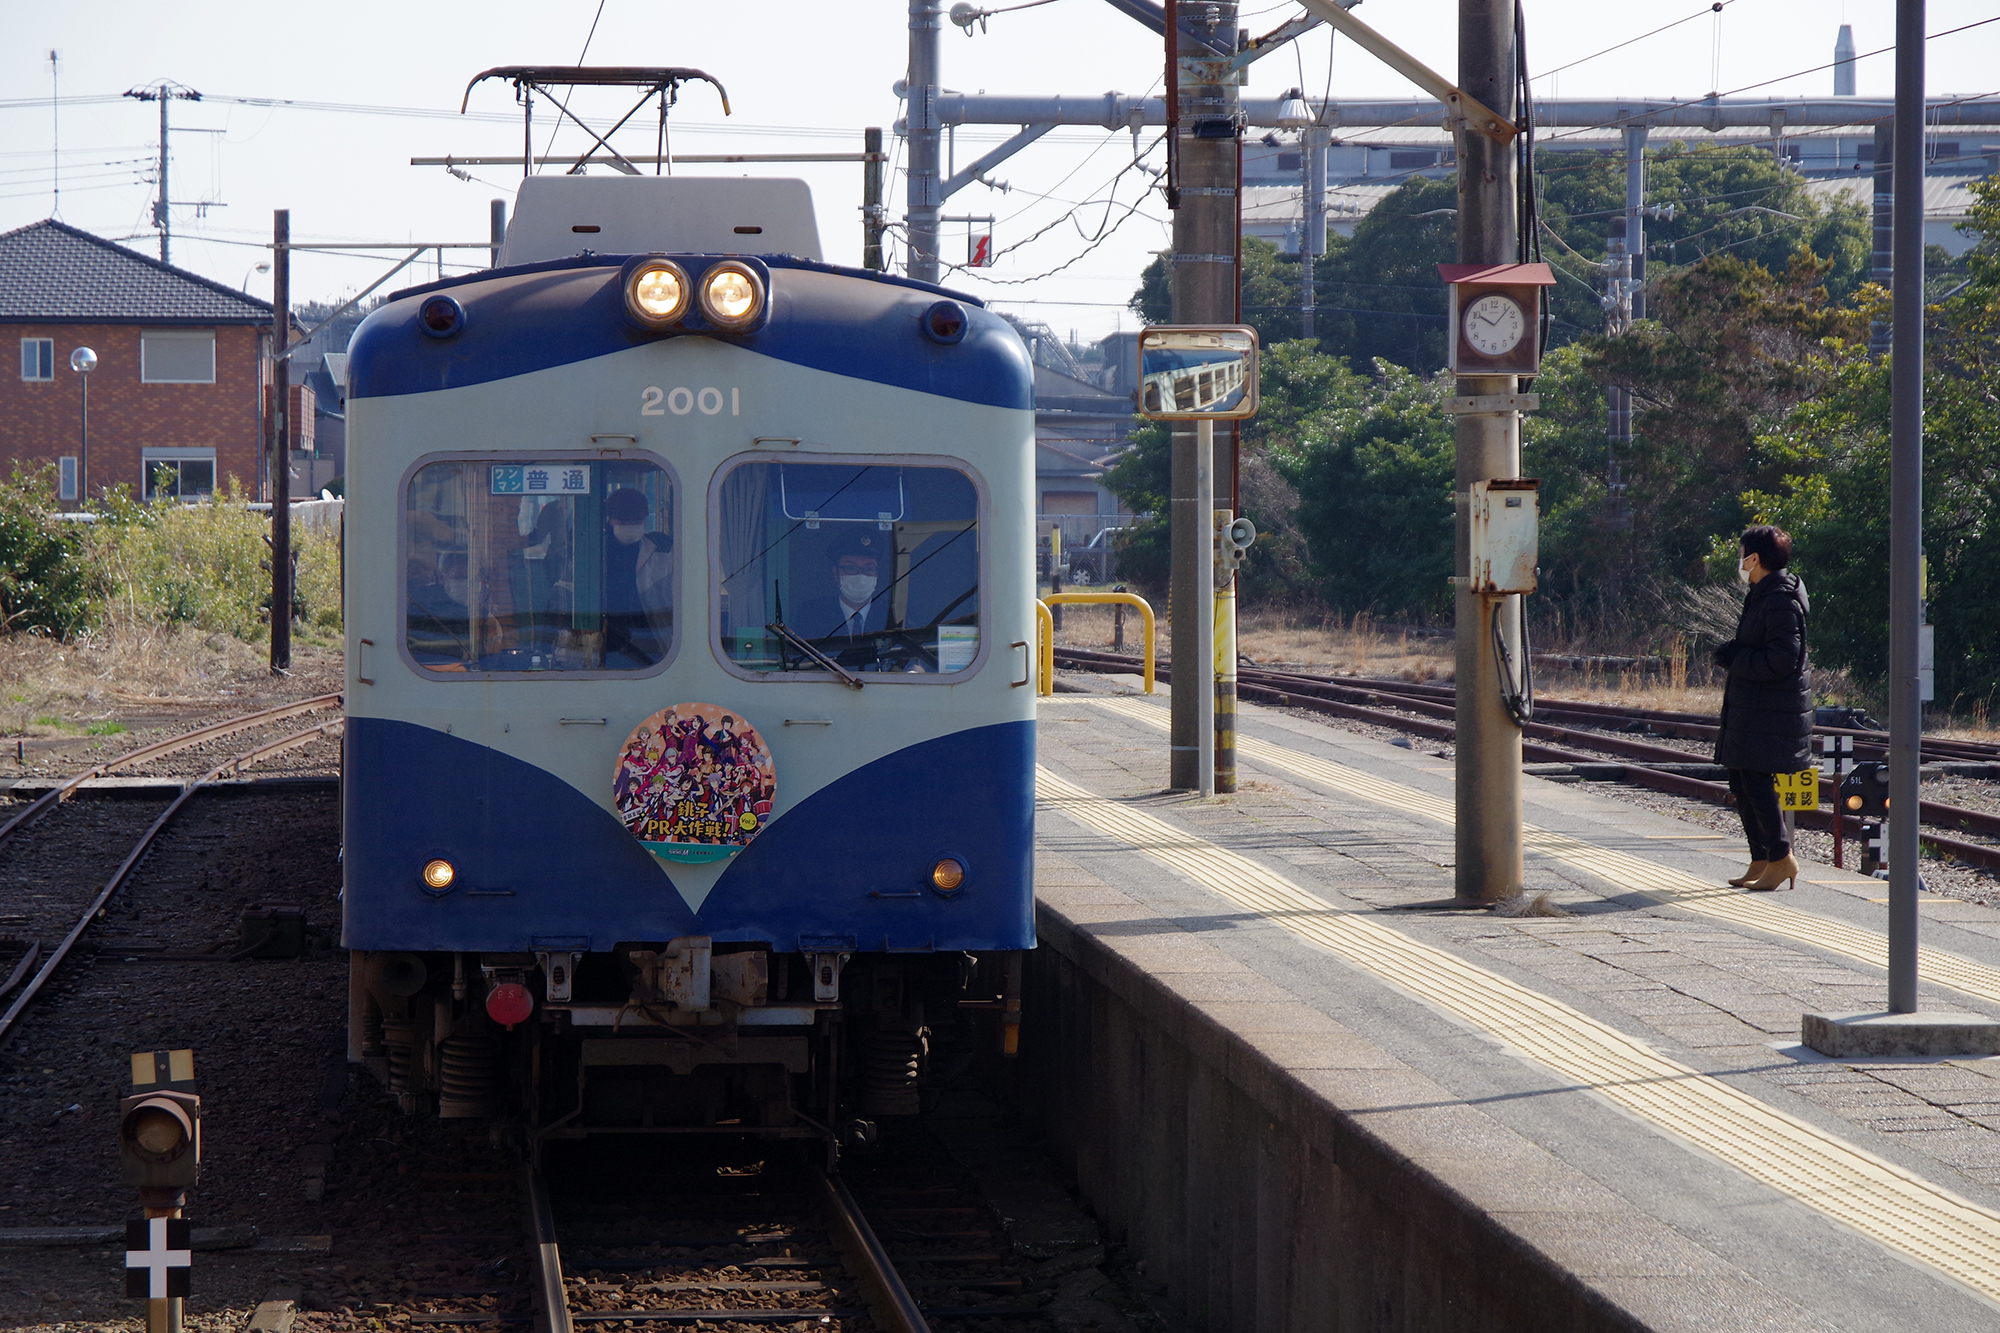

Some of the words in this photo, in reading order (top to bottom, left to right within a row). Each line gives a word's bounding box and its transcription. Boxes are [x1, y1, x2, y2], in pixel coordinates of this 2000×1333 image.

[1481, 303, 1488, 312] 11
[1490, 300, 1499, 309] 12
[1473, 311, 1481, 319] 10
[1509, 310, 1516, 319] 2
[1470, 321, 1476, 330] 9
[1512, 321, 1518, 330] 3
[1473, 331, 1479, 340] 8
[1509, 332, 1514, 341] 4
[1481, 339, 1487, 348] 7
[1491, 342, 1497, 351] 6
[1502, 339, 1507, 348] 5
[641, 386, 740, 416] 2001
[495, 468, 518, 479] ワン
[526, 469, 585, 490] 普通
[498, 481, 521, 491] マン
[1778, 791, 1813, 806] 確認
[677, 801, 710, 818] 銚子
